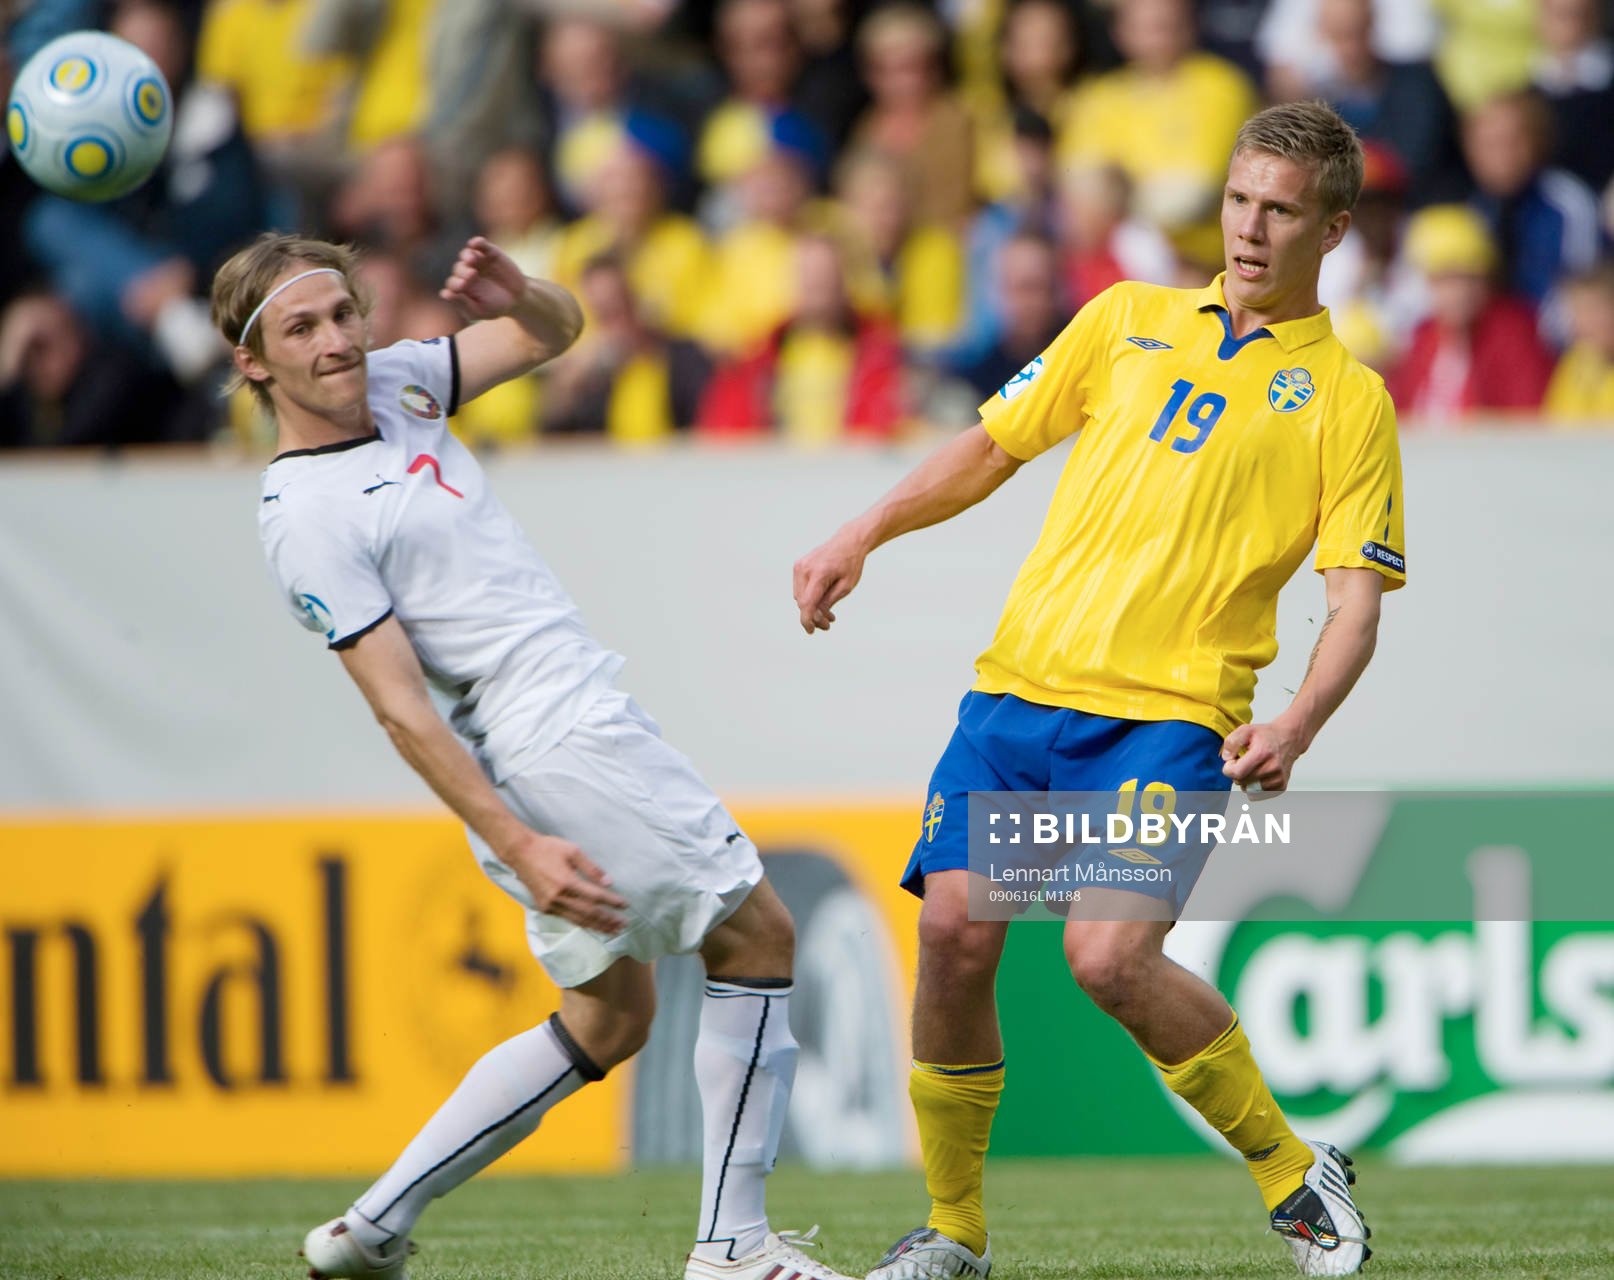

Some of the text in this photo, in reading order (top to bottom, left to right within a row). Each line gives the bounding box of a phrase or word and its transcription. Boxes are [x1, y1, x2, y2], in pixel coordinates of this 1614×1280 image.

[1149, 378, 1227, 454] 19
[1376, 547, 1404, 569] RESPECT
[1114, 778, 1178, 846] 19
[3, 848, 359, 1092] ntal
